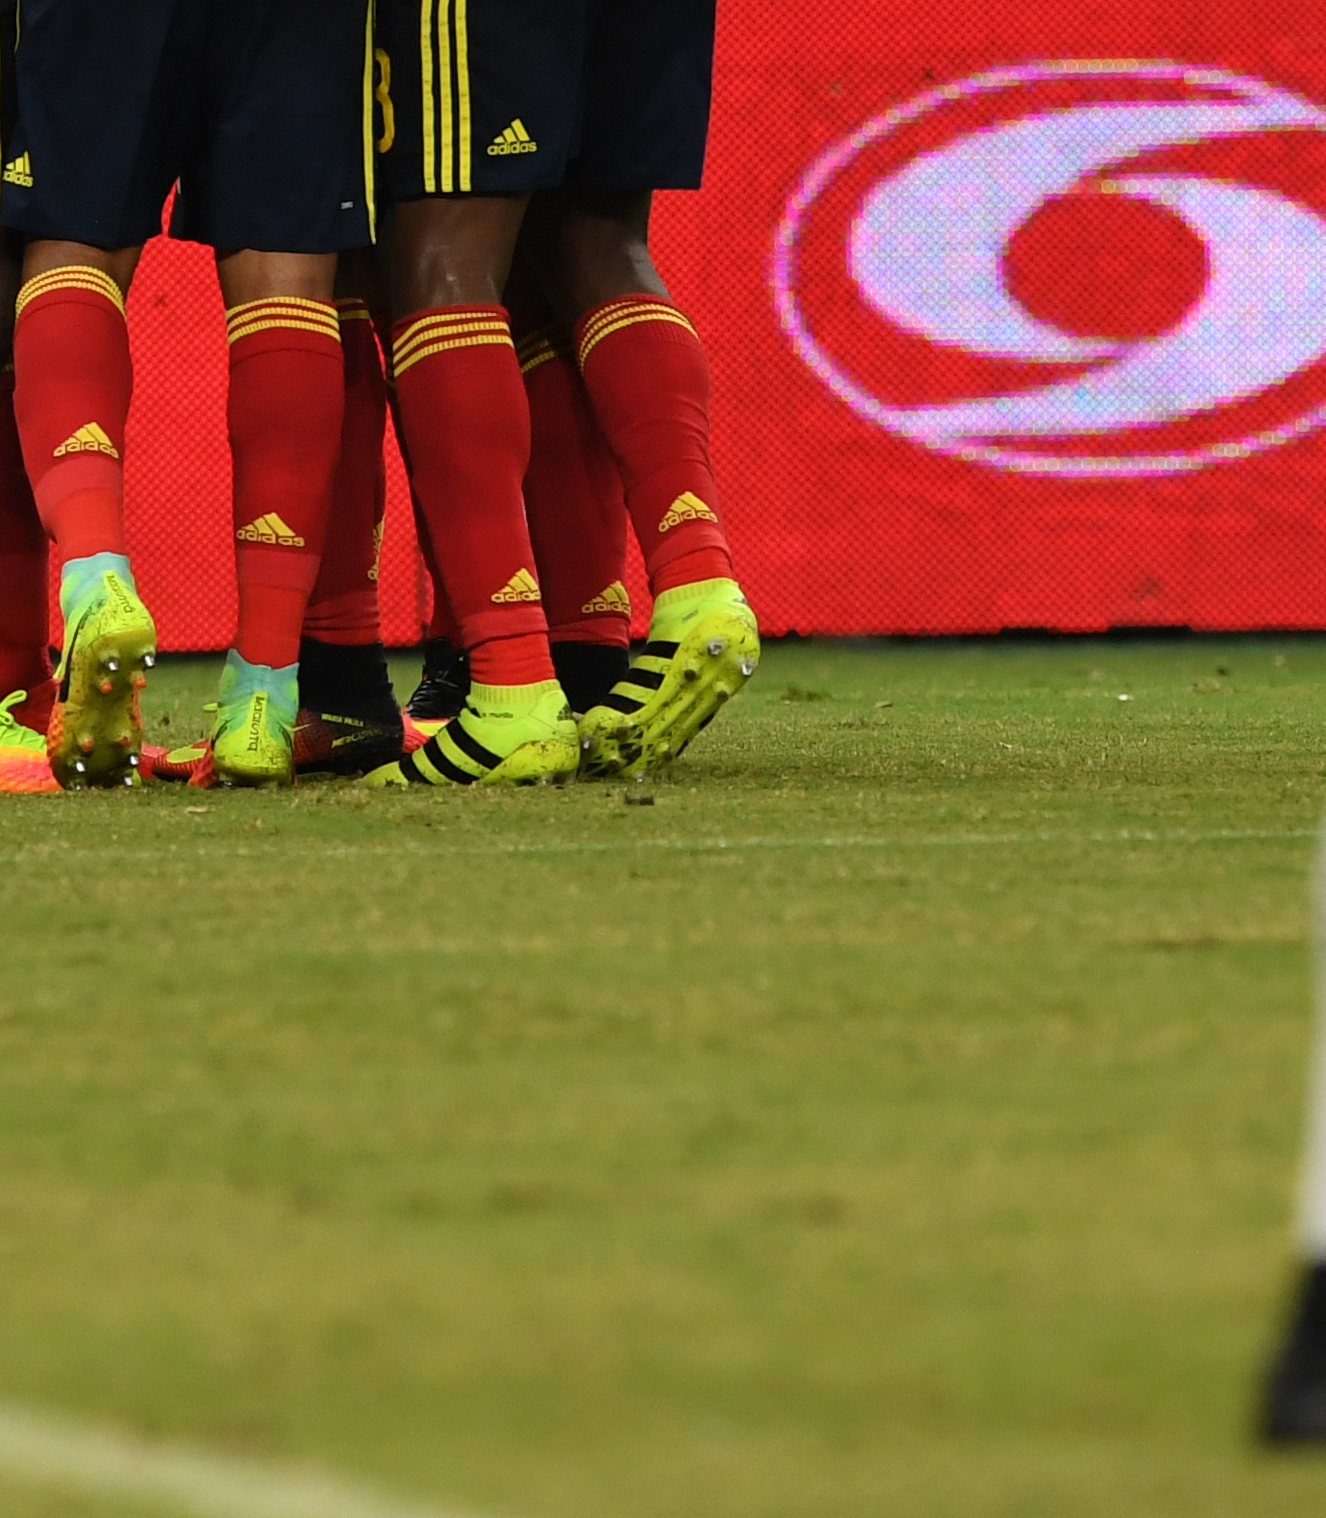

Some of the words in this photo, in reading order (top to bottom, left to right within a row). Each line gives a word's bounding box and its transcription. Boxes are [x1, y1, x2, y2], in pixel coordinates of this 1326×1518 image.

[487, 141, 537, 155] adidas
[2, 170, 34, 188] didas
[53, 440, 119, 459] adidas
[658, 510, 719, 533] adidas
[236, 528, 305, 547] adidas
